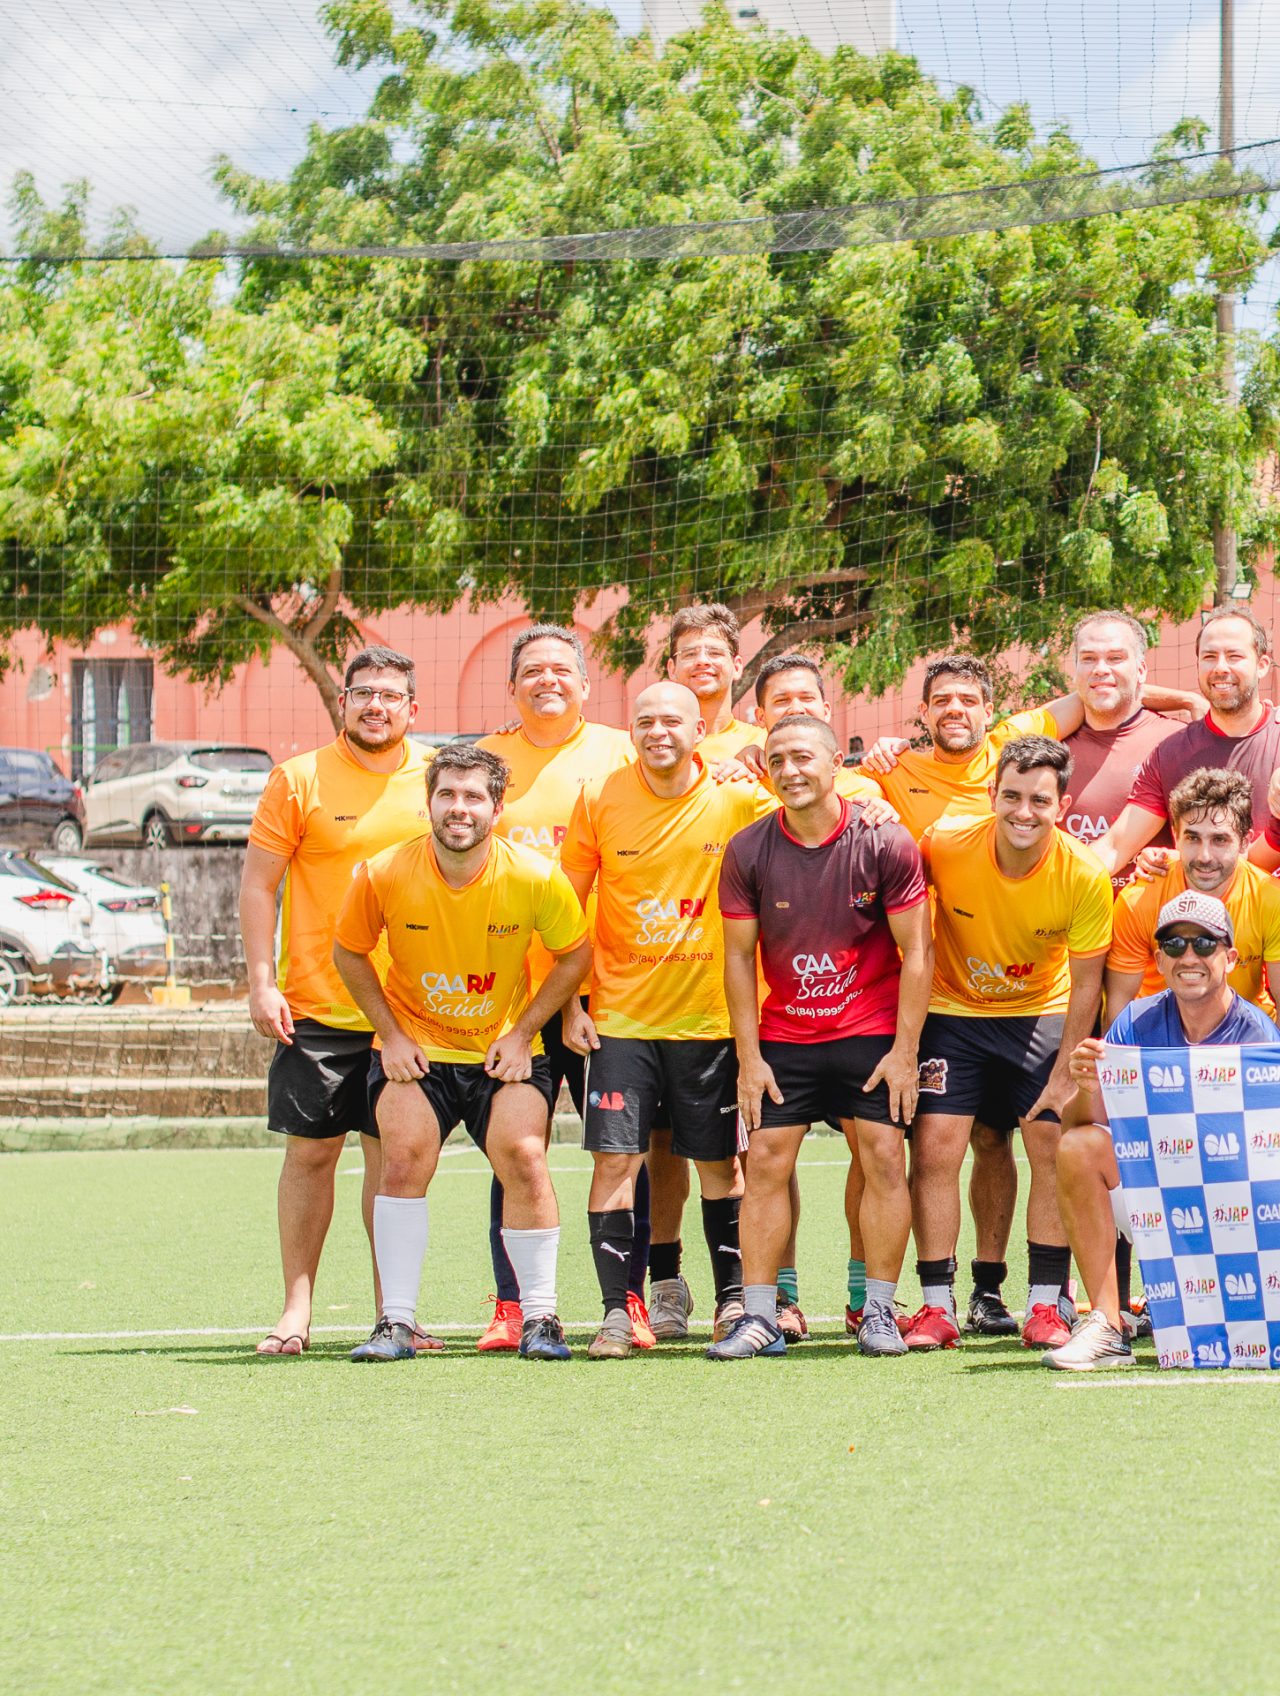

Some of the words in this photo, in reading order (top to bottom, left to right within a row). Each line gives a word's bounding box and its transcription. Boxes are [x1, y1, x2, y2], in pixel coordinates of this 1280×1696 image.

[508, 825, 568, 848] CAAR
[1066, 813, 1111, 838] CAA
[421, 971, 497, 995] CAARN
[423, 990, 497, 1018] Saúde
[446, 1018, 502, 1038] 99952-910
[1148, 1065, 1185, 1087] OAB
[589, 1089, 626, 1111] OAB
[1114, 1141, 1149, 1158] CAARN
[1204, 1132, 1240, 1156] OAB
[1171, 1206, 1204, 1229] OAB
[1224, 1272, 1257, 1295] OAB
